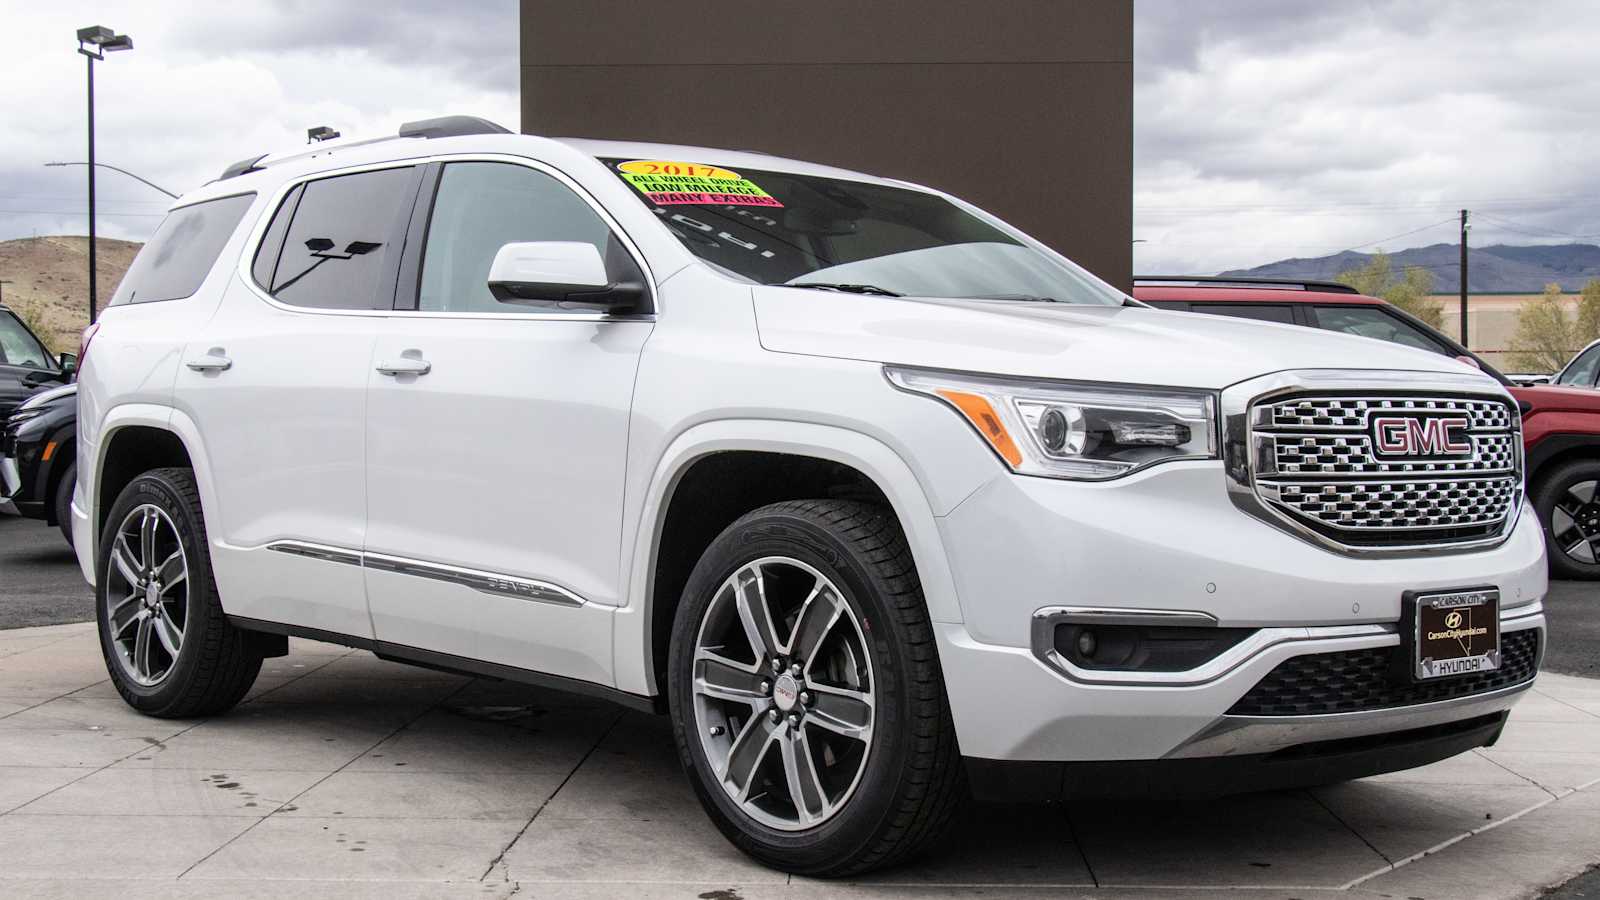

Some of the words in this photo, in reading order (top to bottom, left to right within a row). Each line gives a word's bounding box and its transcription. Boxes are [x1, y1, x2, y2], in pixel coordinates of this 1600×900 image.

[642, 164, 715, 177] 2017
[660, 175, 708, 184] WHEEL
[710, 178, 747, 186] DRIVE
[643, 183, 682, 192] LOW
[684, 184, 760, 195] MILEAGE
[650, 192, 705, 202] MANY
[708, 194, 778, 205] EXTRAS
[1374, 416, 1471, 455] GMC
[1439, 658, 1480, 675] HYUNDAI
